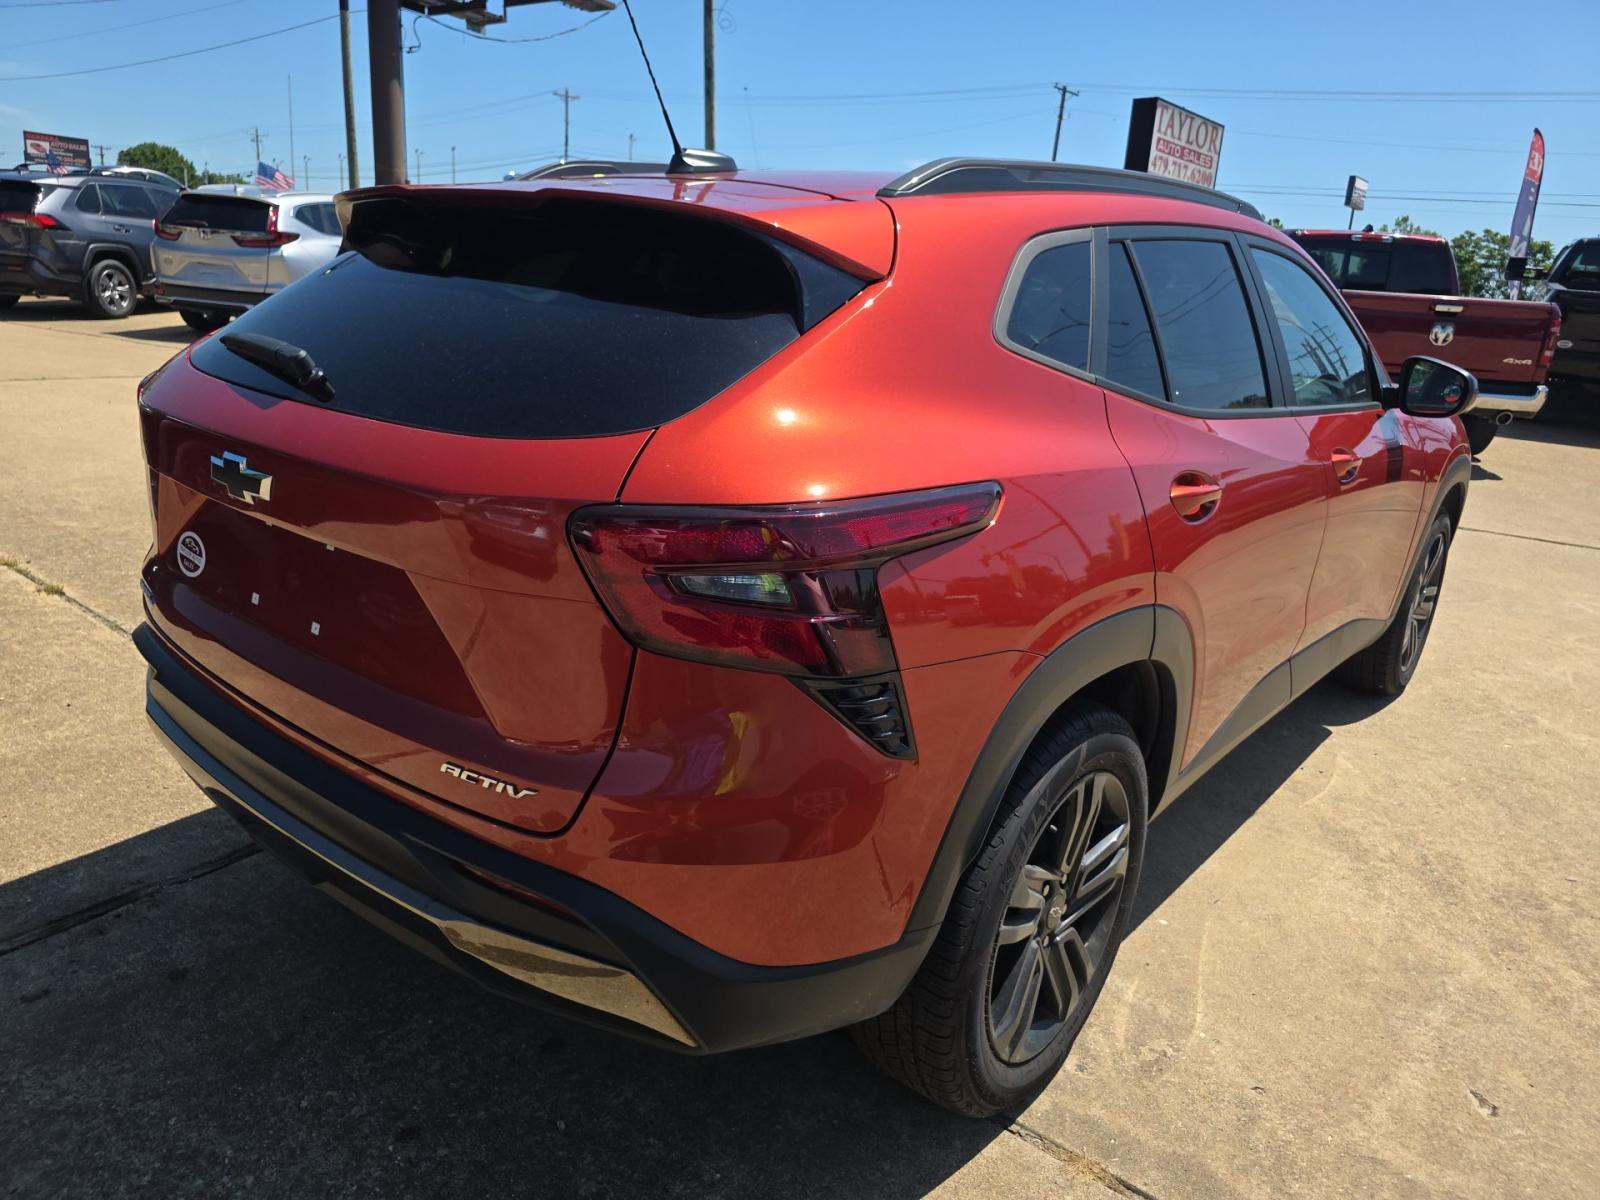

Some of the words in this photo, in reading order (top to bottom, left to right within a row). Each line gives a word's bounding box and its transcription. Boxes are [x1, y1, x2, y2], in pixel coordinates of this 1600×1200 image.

[1156, 102, 1220, 155] TAYLOR
[1157, 139, 1181, 157] AUTO
[1183, 149, 1212, 167] SALES
[439, 762, 539, 800] ACTIV
